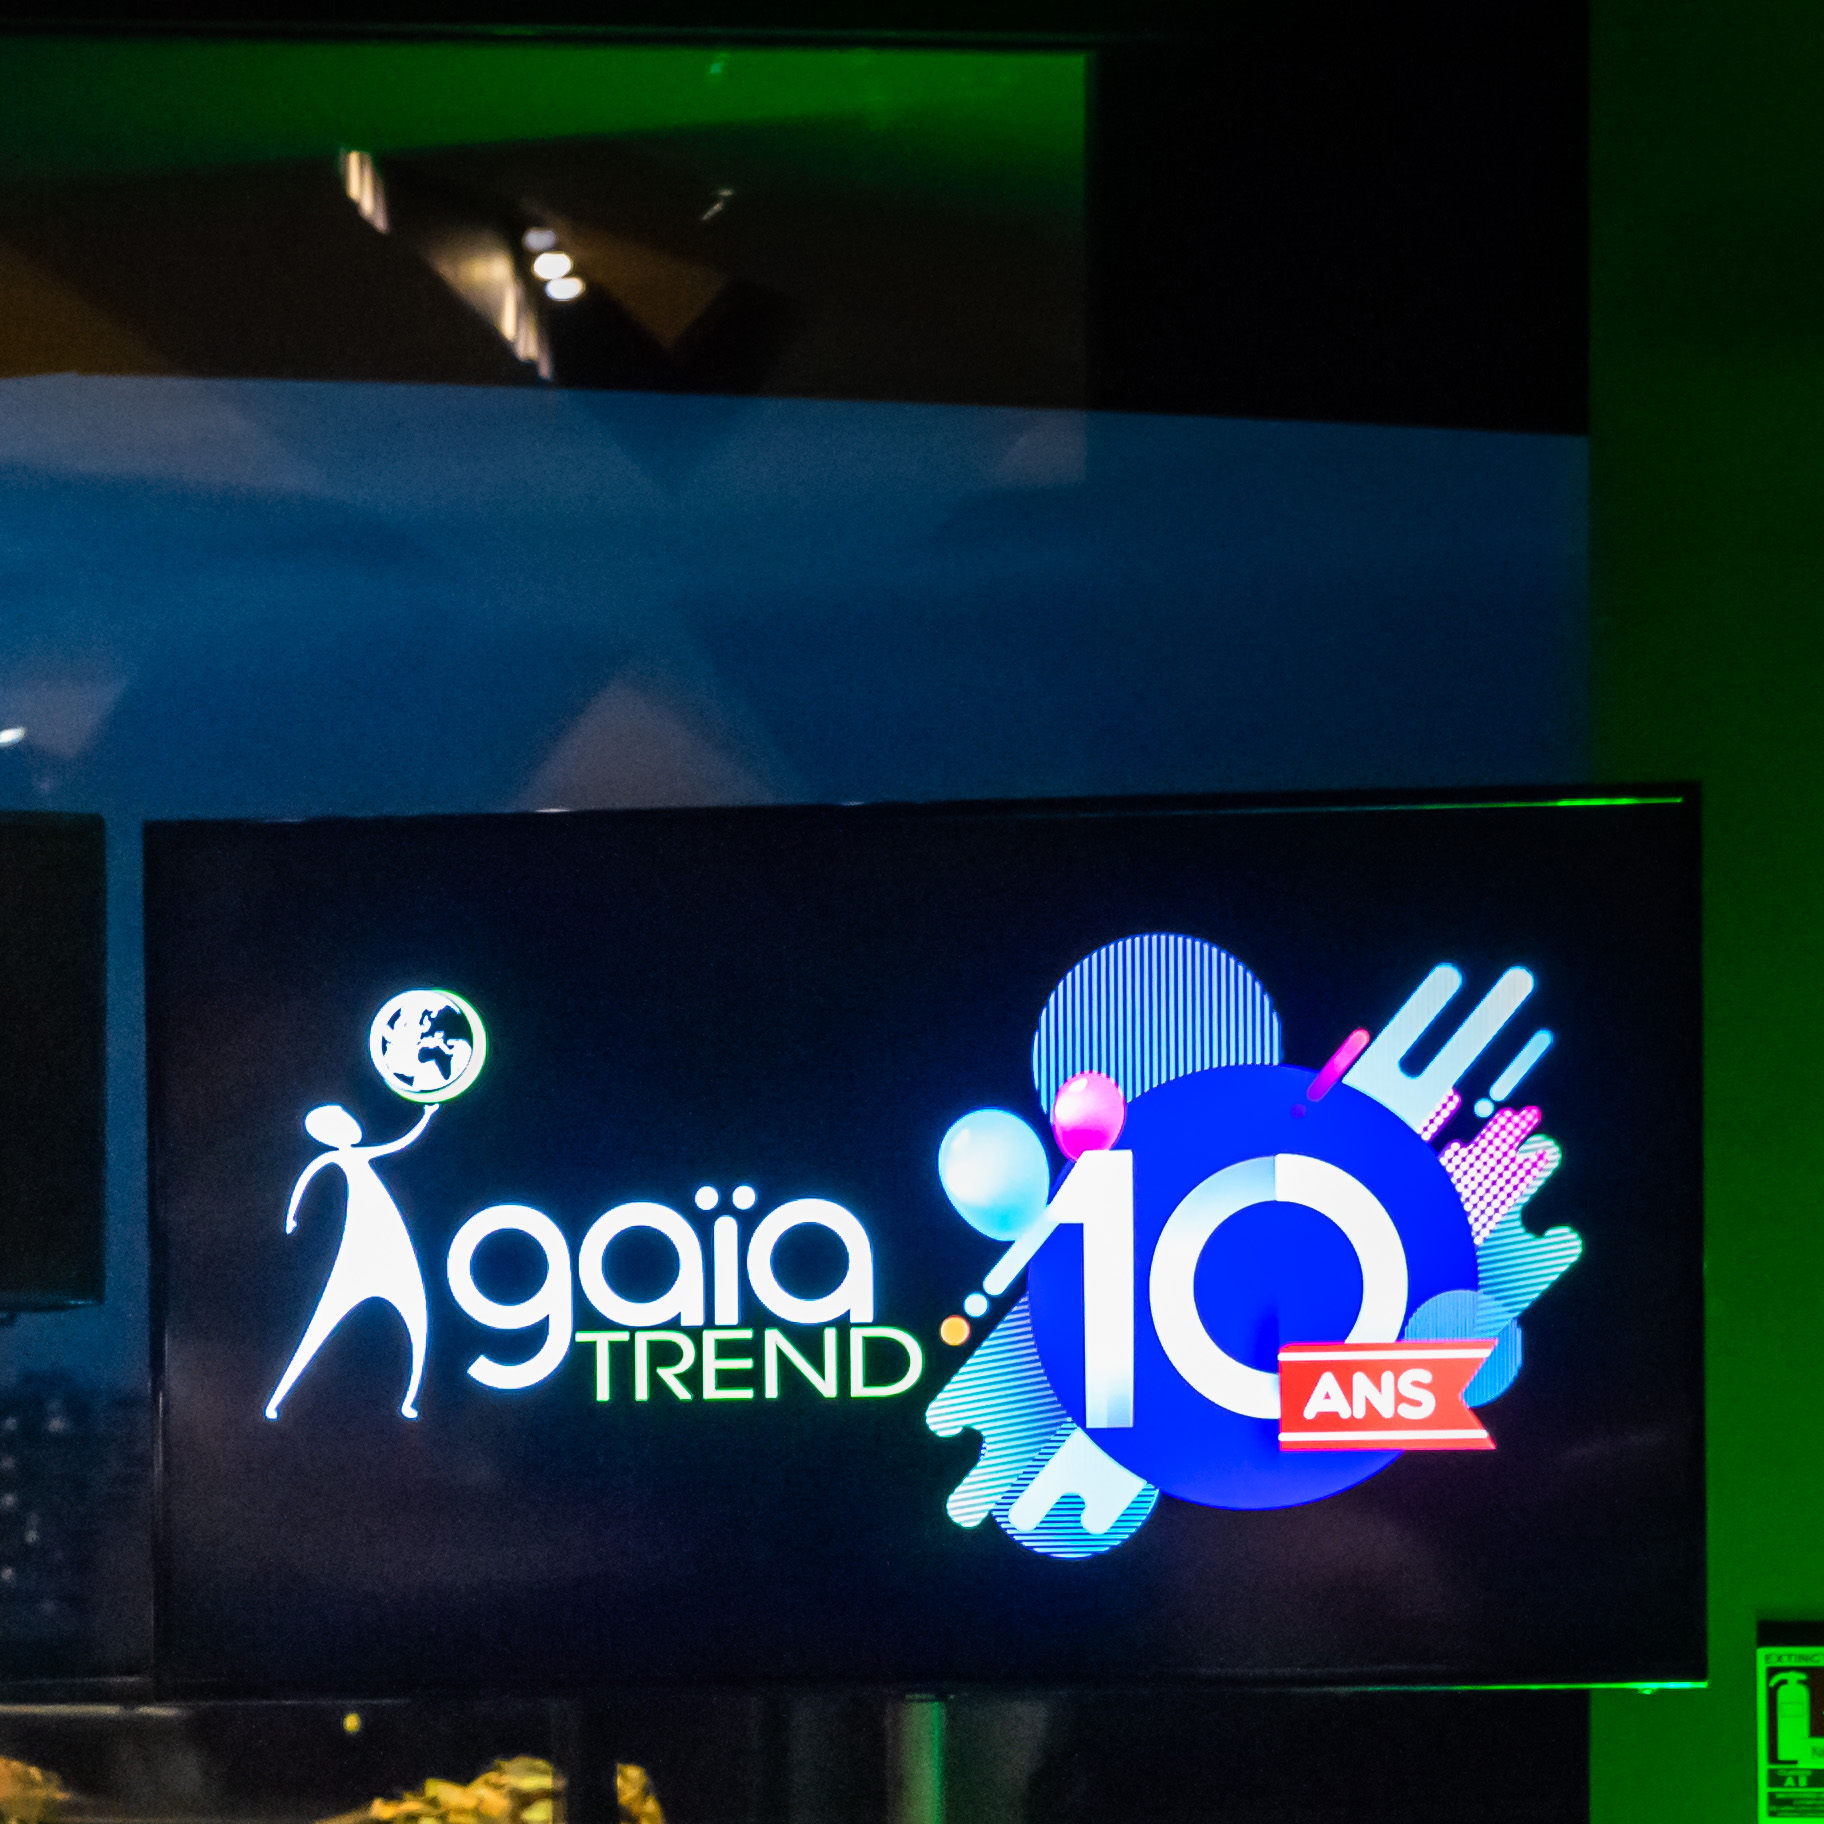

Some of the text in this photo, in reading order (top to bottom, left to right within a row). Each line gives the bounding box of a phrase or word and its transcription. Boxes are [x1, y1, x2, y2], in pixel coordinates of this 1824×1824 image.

[445, 1185, 875, 1390] gaïa
[984, 1149, 1410, 1428] 10
[574, 1326, 925, 1402] TREND
[1302, 1366, 1438, 1422] ANS
